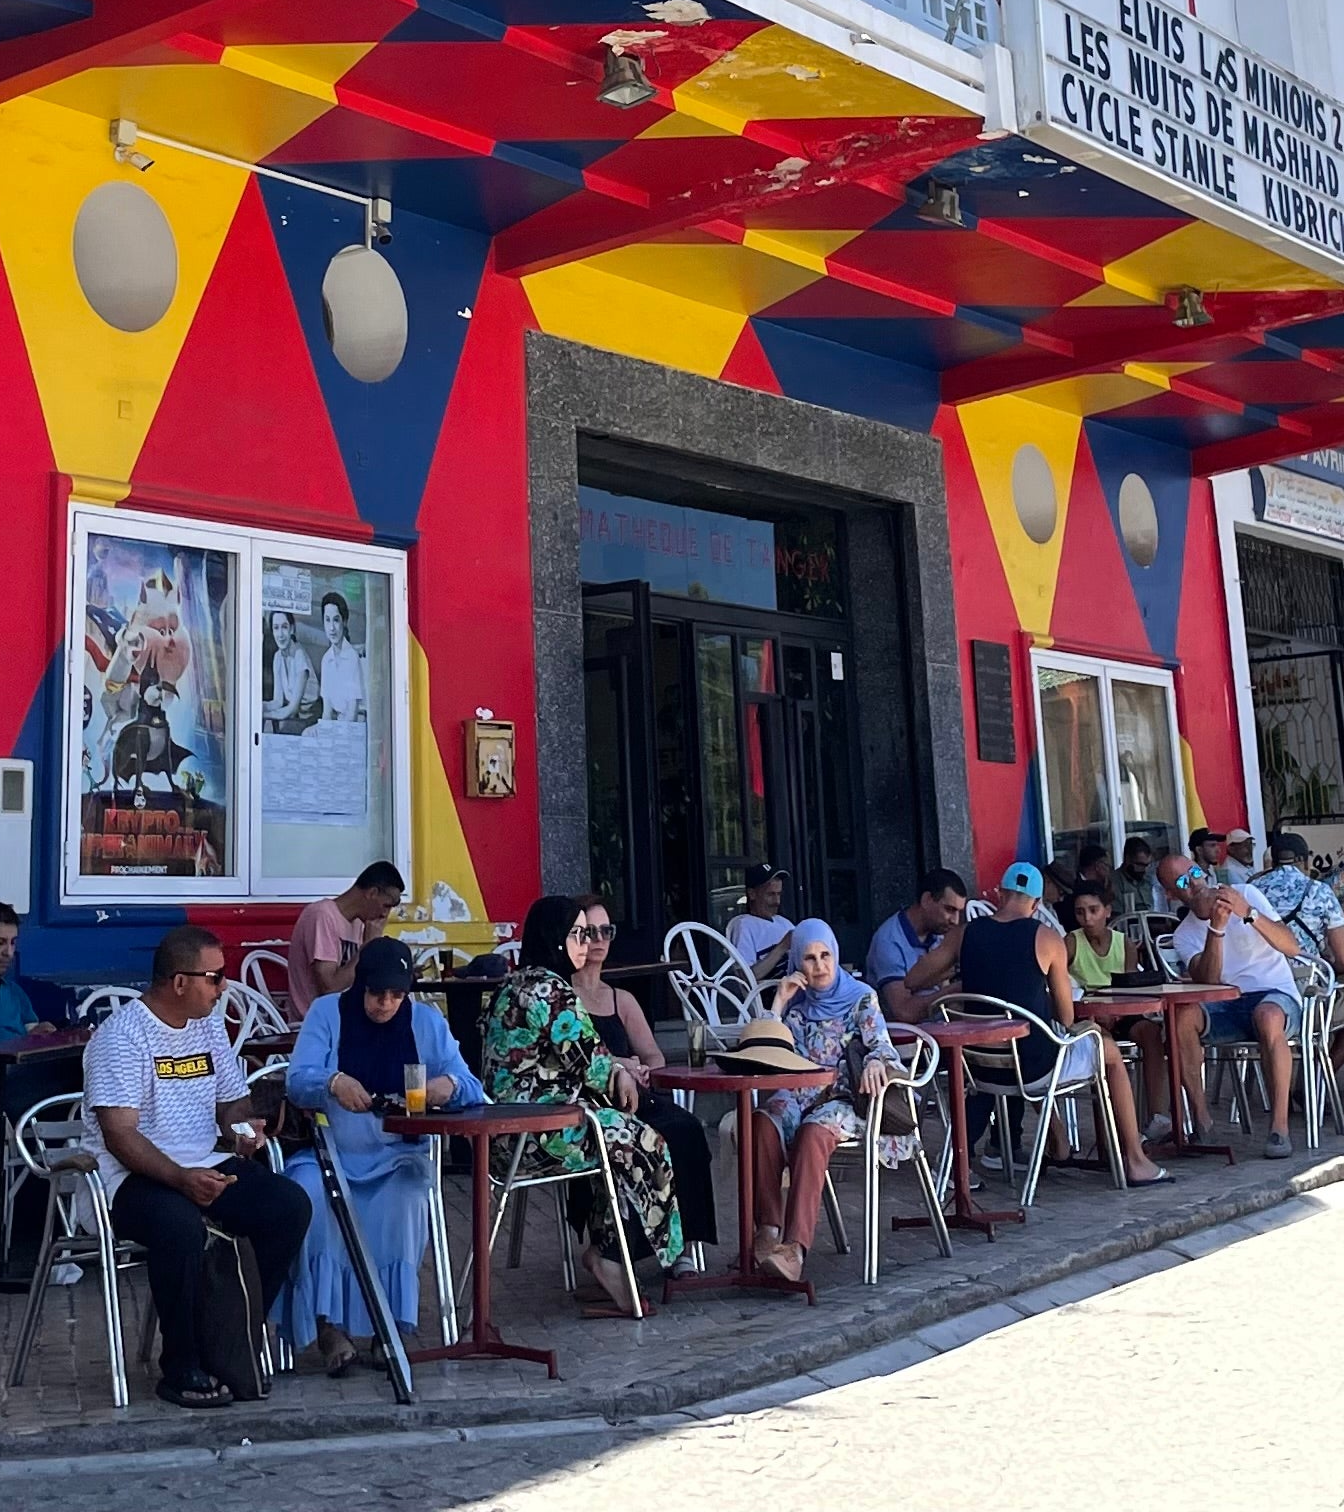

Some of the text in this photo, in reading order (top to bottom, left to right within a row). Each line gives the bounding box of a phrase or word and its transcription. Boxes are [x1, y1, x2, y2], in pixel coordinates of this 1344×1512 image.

[1061, 73, 1144, 158] CYCLE
[1152, 121, 1237, 203] STANLE
[1065, 14, 1339, 197] LES NUITS DE MASHHAD
[1245, 58, 1326, 140] MINIONS
[1332, 109, 1343, 151] 2
[580, 506, 700, 560] MATHEQUE
[104, 809, 180, 834] KRYPTO
[157, 1059, 208, 1074] LOS NGELES
